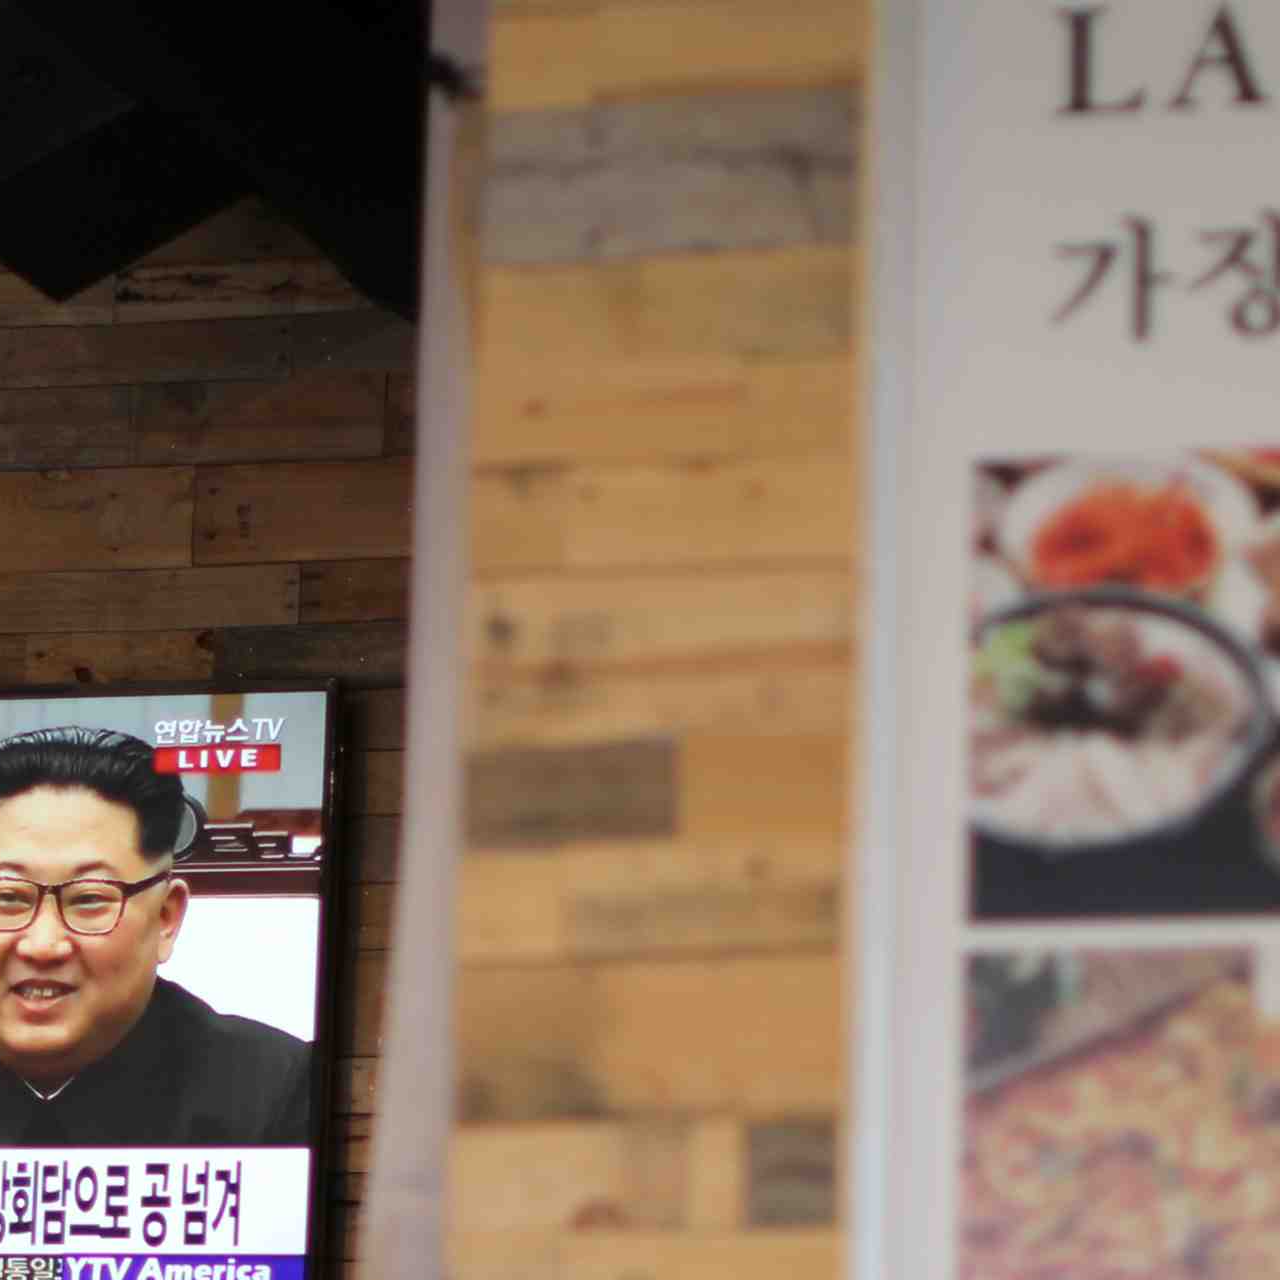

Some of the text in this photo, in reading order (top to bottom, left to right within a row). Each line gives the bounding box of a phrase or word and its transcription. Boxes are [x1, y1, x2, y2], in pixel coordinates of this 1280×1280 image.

[1056, 5, 1268, 116] LA
[154, 717, 284, 744] 연합뉴스TV
[177, 749, 258, 769] LIVE
[141, 1162, 172, 1247] 공
[181, 1160, 242, 1247] 넘겨
